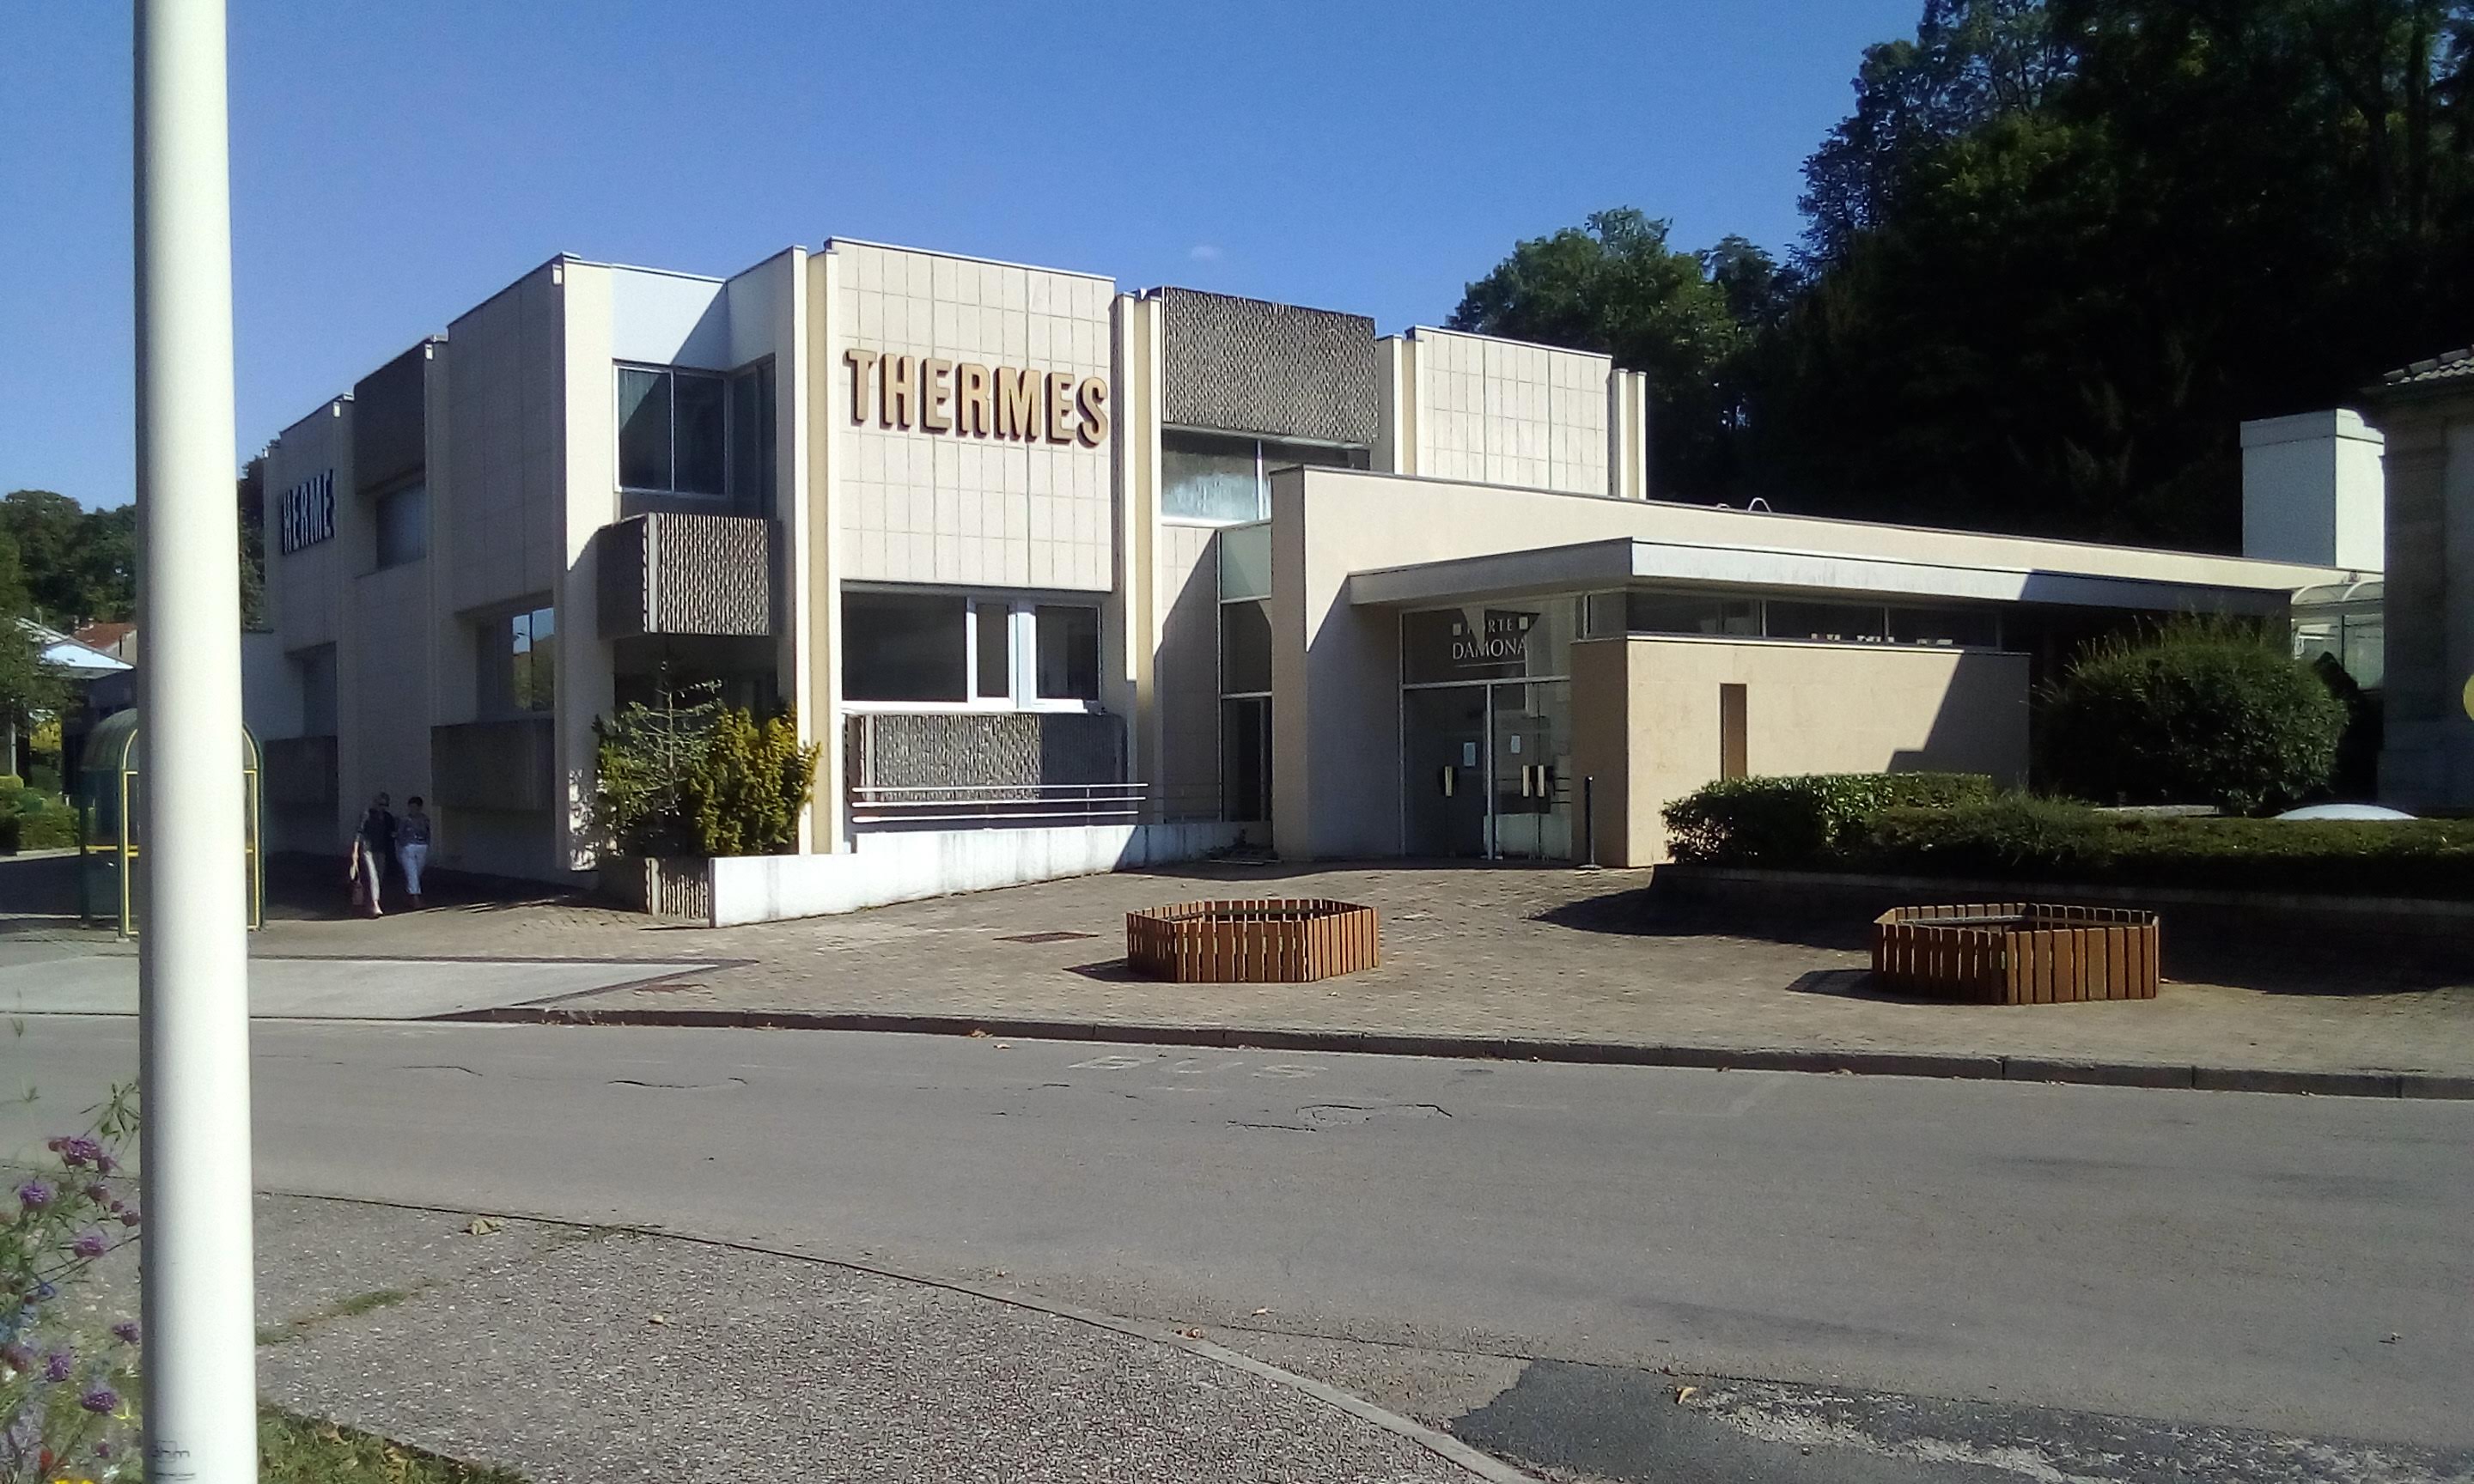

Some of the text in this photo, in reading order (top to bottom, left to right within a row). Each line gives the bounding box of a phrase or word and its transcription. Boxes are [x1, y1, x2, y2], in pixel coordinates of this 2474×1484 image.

[843, 348, 1108, 447] THERMES
[1453, 637, 1526, 660] DAMONA
[1067, 1055, 1329, 1078] BUS
